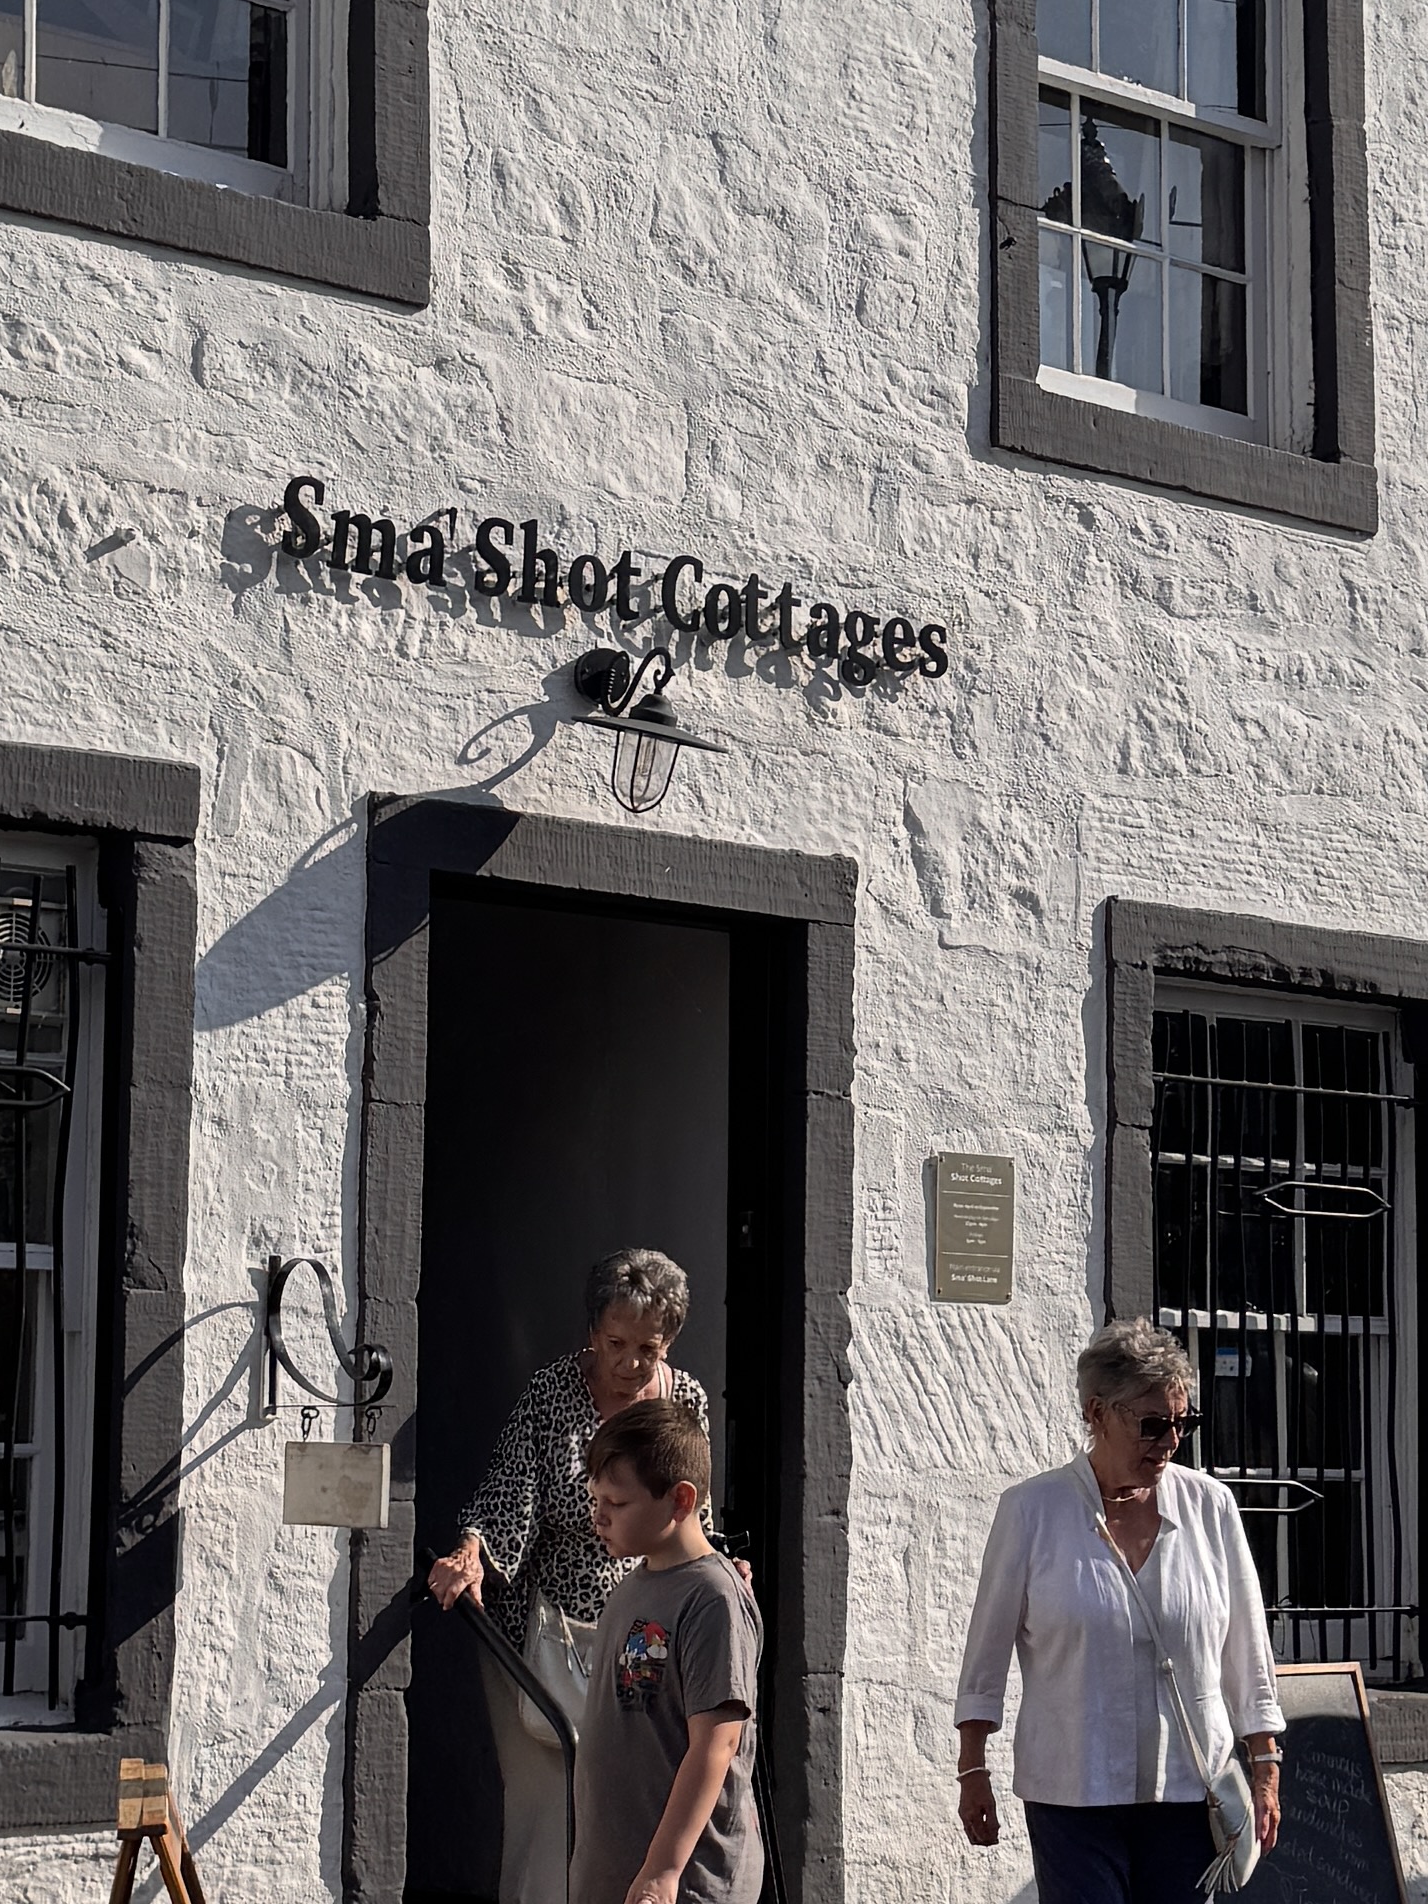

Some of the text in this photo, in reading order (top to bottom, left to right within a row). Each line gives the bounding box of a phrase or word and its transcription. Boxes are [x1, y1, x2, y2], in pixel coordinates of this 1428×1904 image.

[474, 517, 642, 621] Shot
[662, 555, 949, 686] Cottages
[950, 1172, 1002, 1186] Shot Cottages
